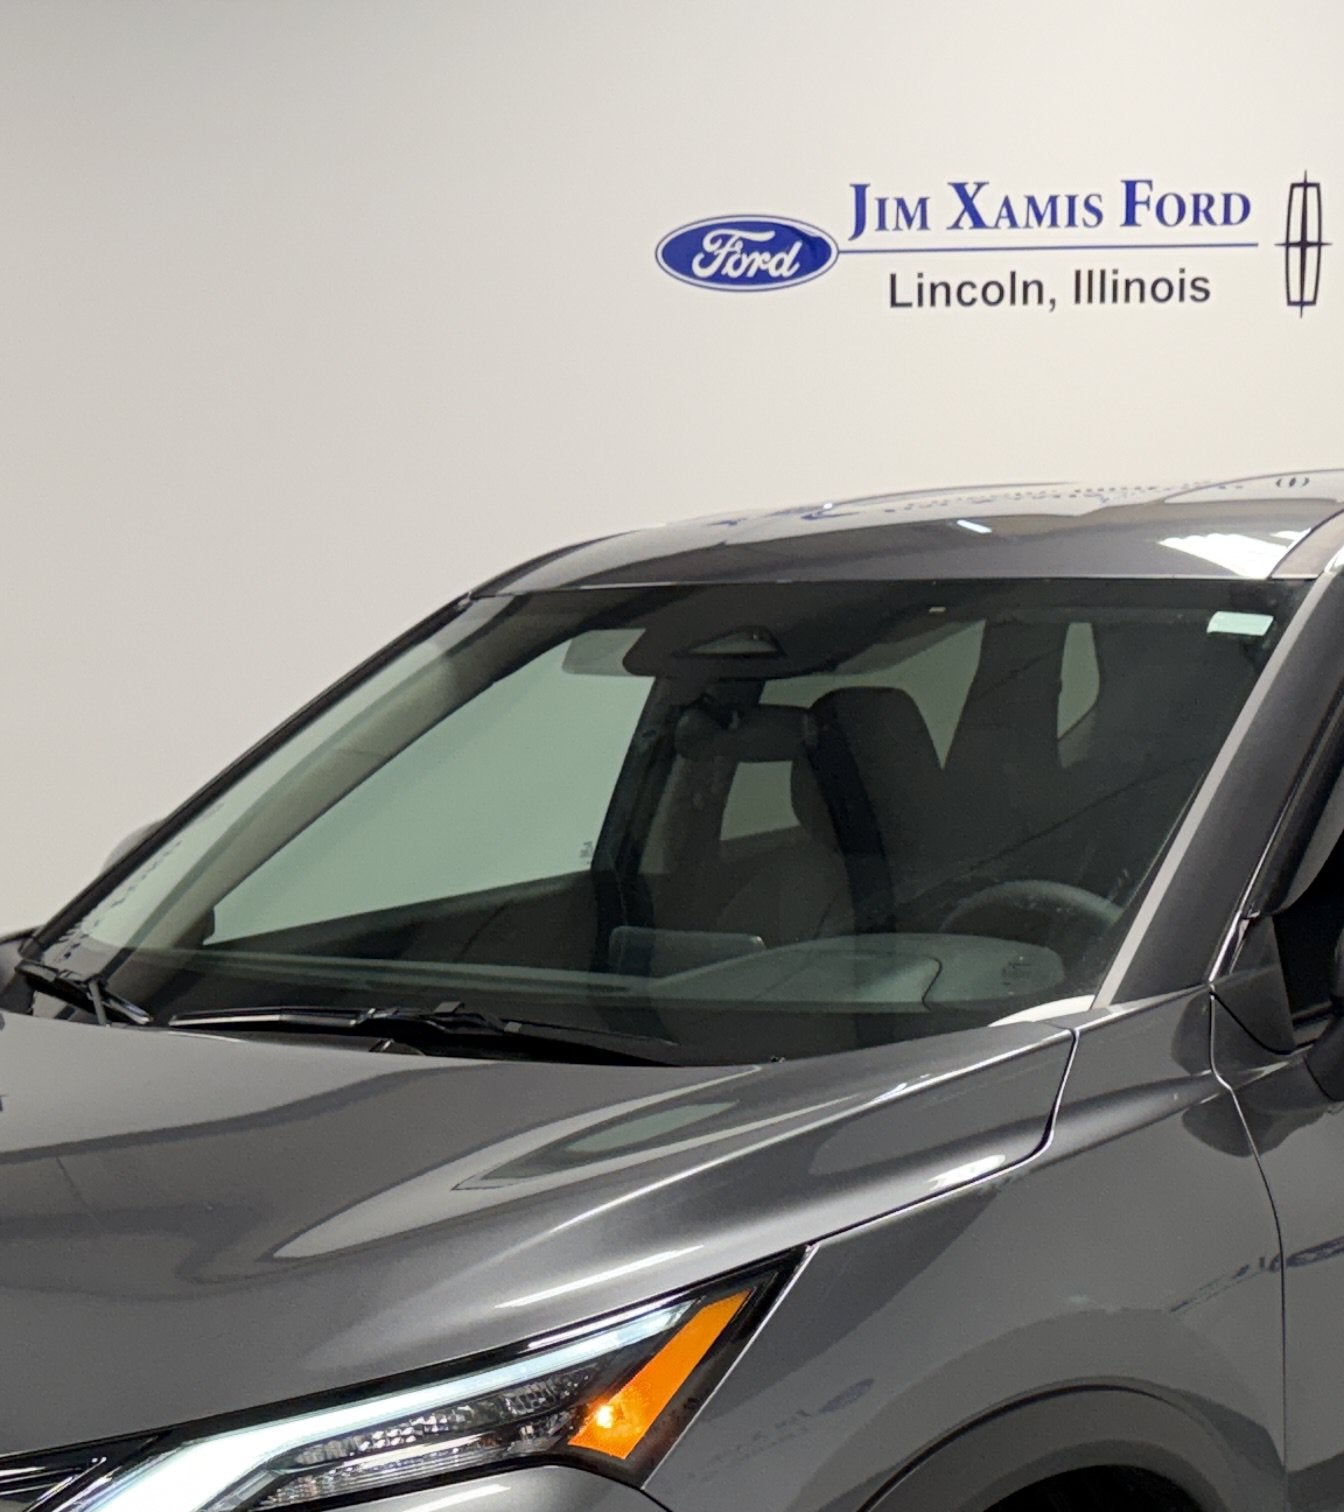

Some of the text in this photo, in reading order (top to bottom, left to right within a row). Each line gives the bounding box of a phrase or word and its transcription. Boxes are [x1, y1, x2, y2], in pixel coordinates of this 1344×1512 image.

[847, 178, 1252, 241] JIM XAMIS FORD
[692, 229, 801, 278] Ford
[889, 267, 1212, 313] Lincoln, Illinois
